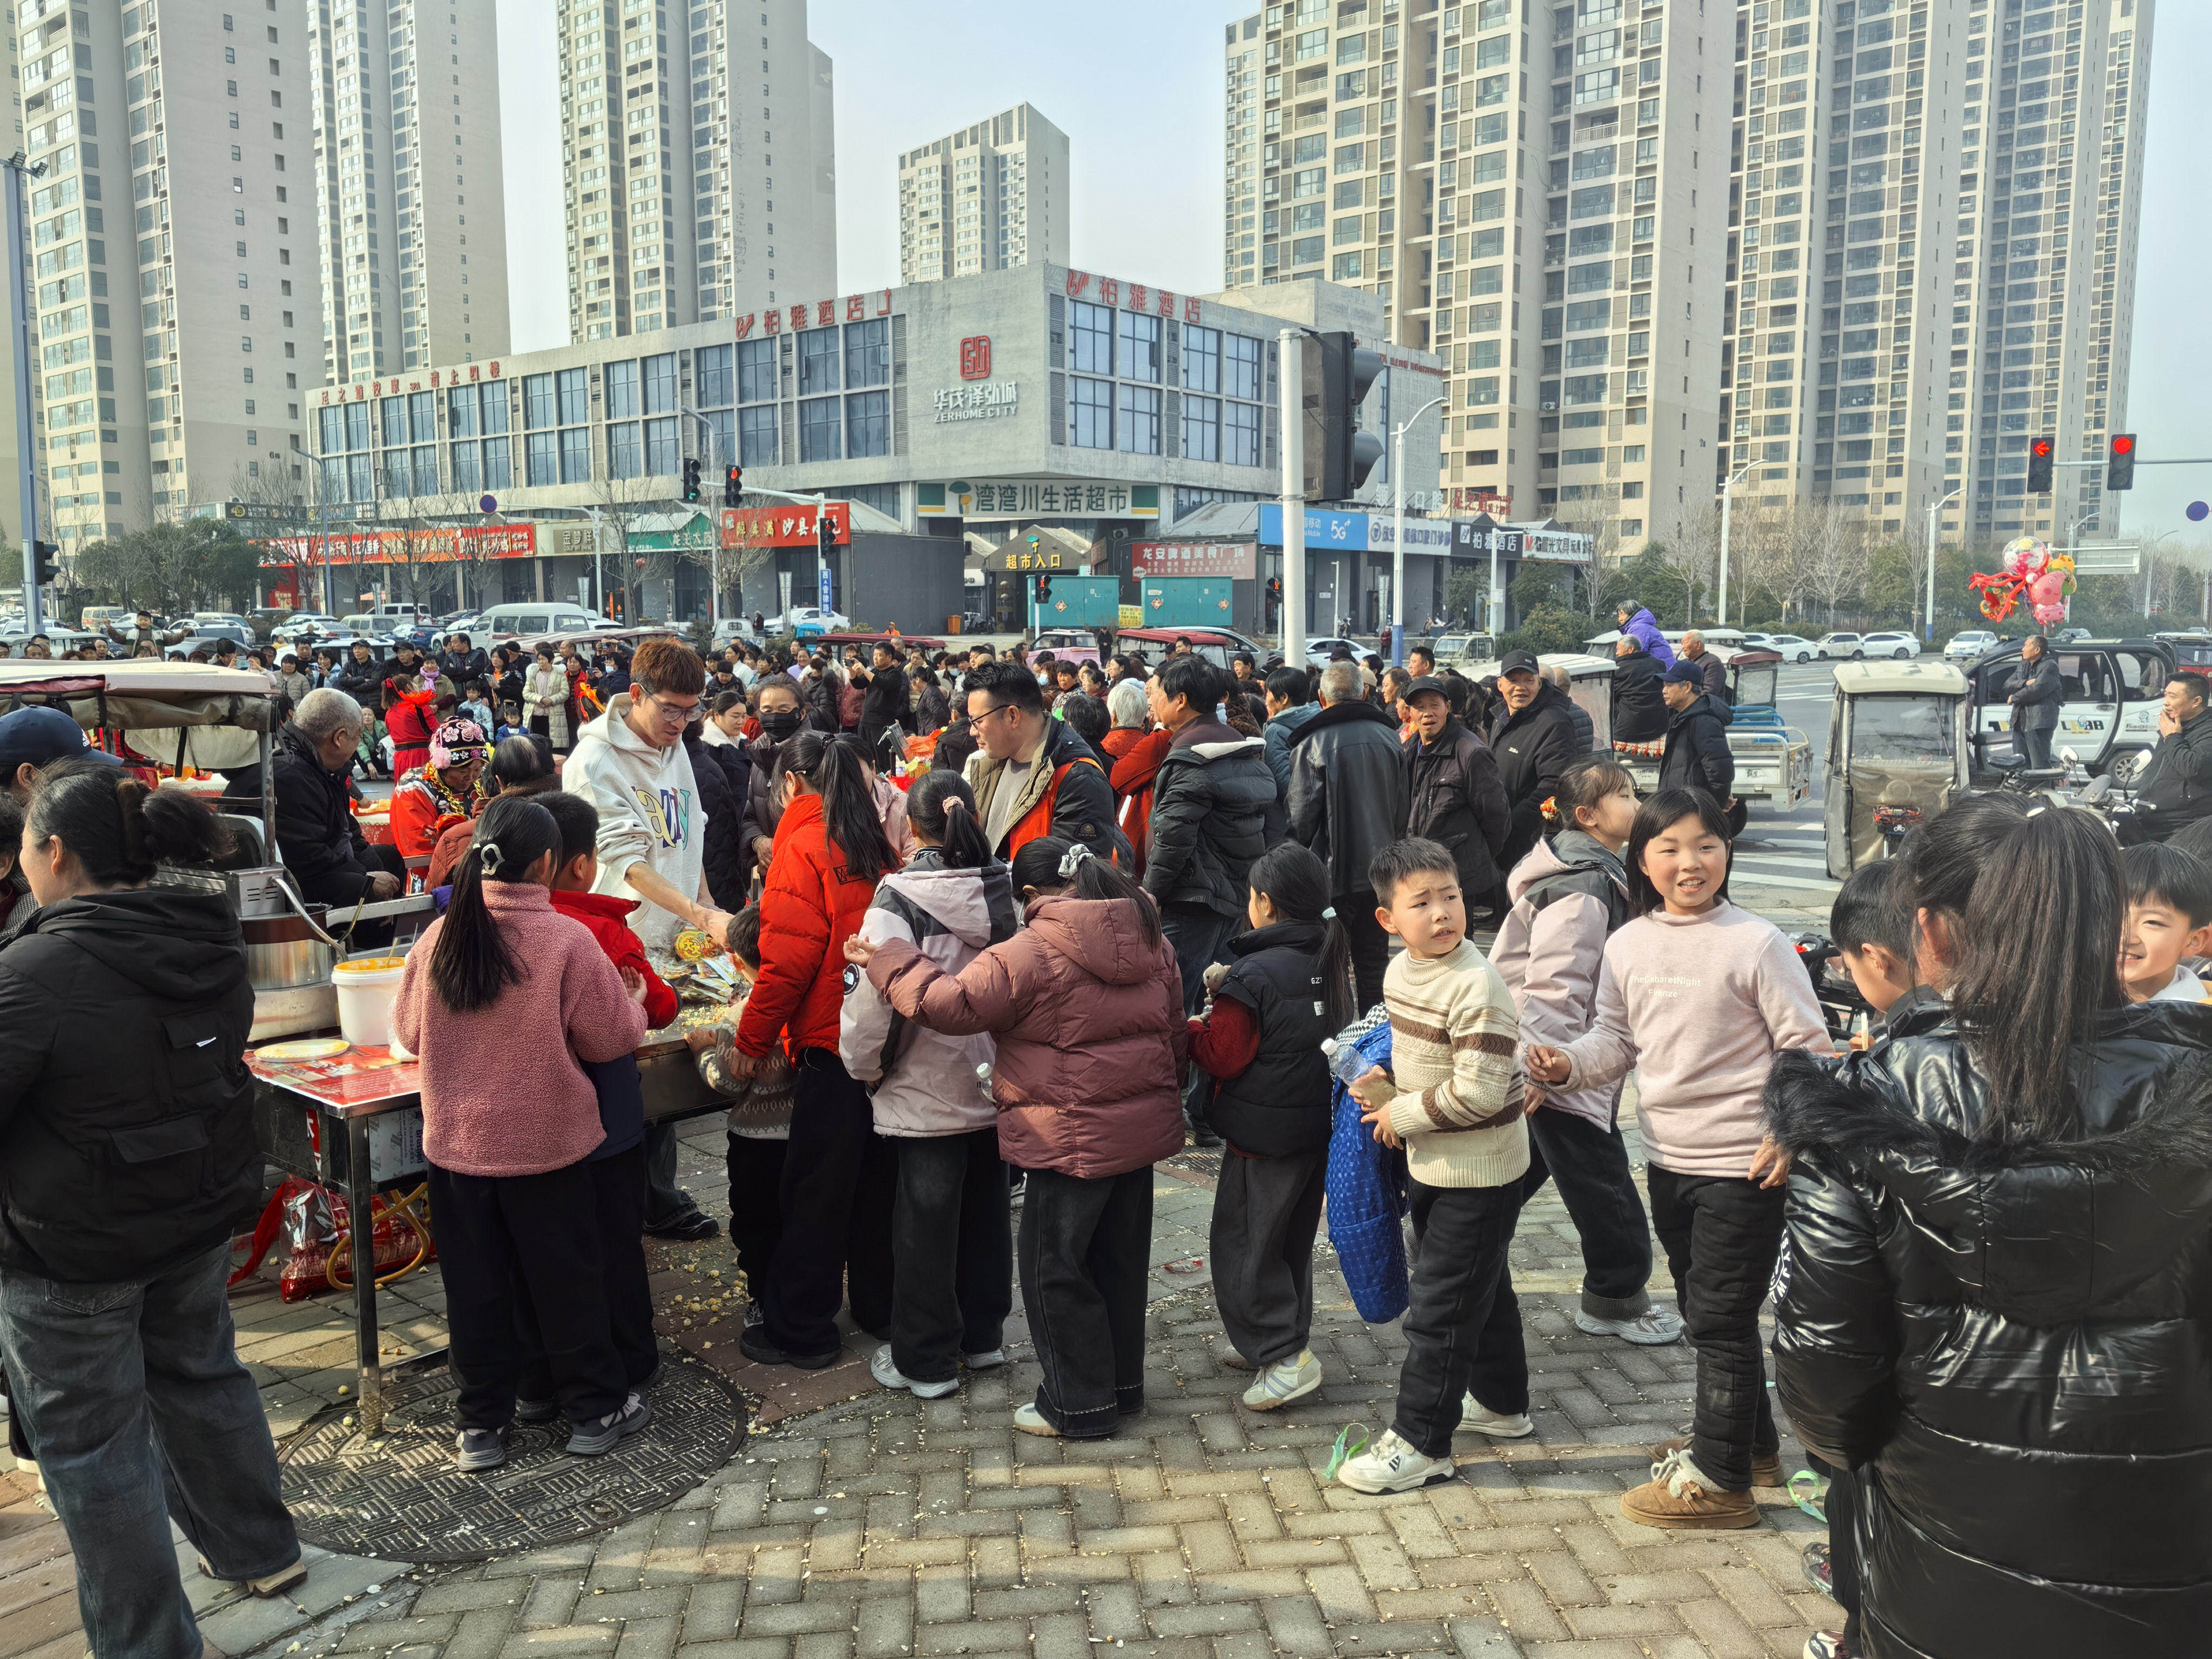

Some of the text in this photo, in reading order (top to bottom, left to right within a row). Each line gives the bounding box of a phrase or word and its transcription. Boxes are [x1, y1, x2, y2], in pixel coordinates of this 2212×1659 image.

[1100, 276, 1201, 323] 柏雅酒店
[764, 294, 864, 334] 柏雅酒店
[934, 405, 1017, 423] ZERHOME CITY
[975, 484, 1128, 512] 湾湾川生活超市
[1472, 532, 1517, 552] 柏雅酒店
[1006, 554, 1061, 570] 超市入口
[1630, 975, 1701, 987] TheCabaretNight
[1648, 988, 1678, 998] Firenze
